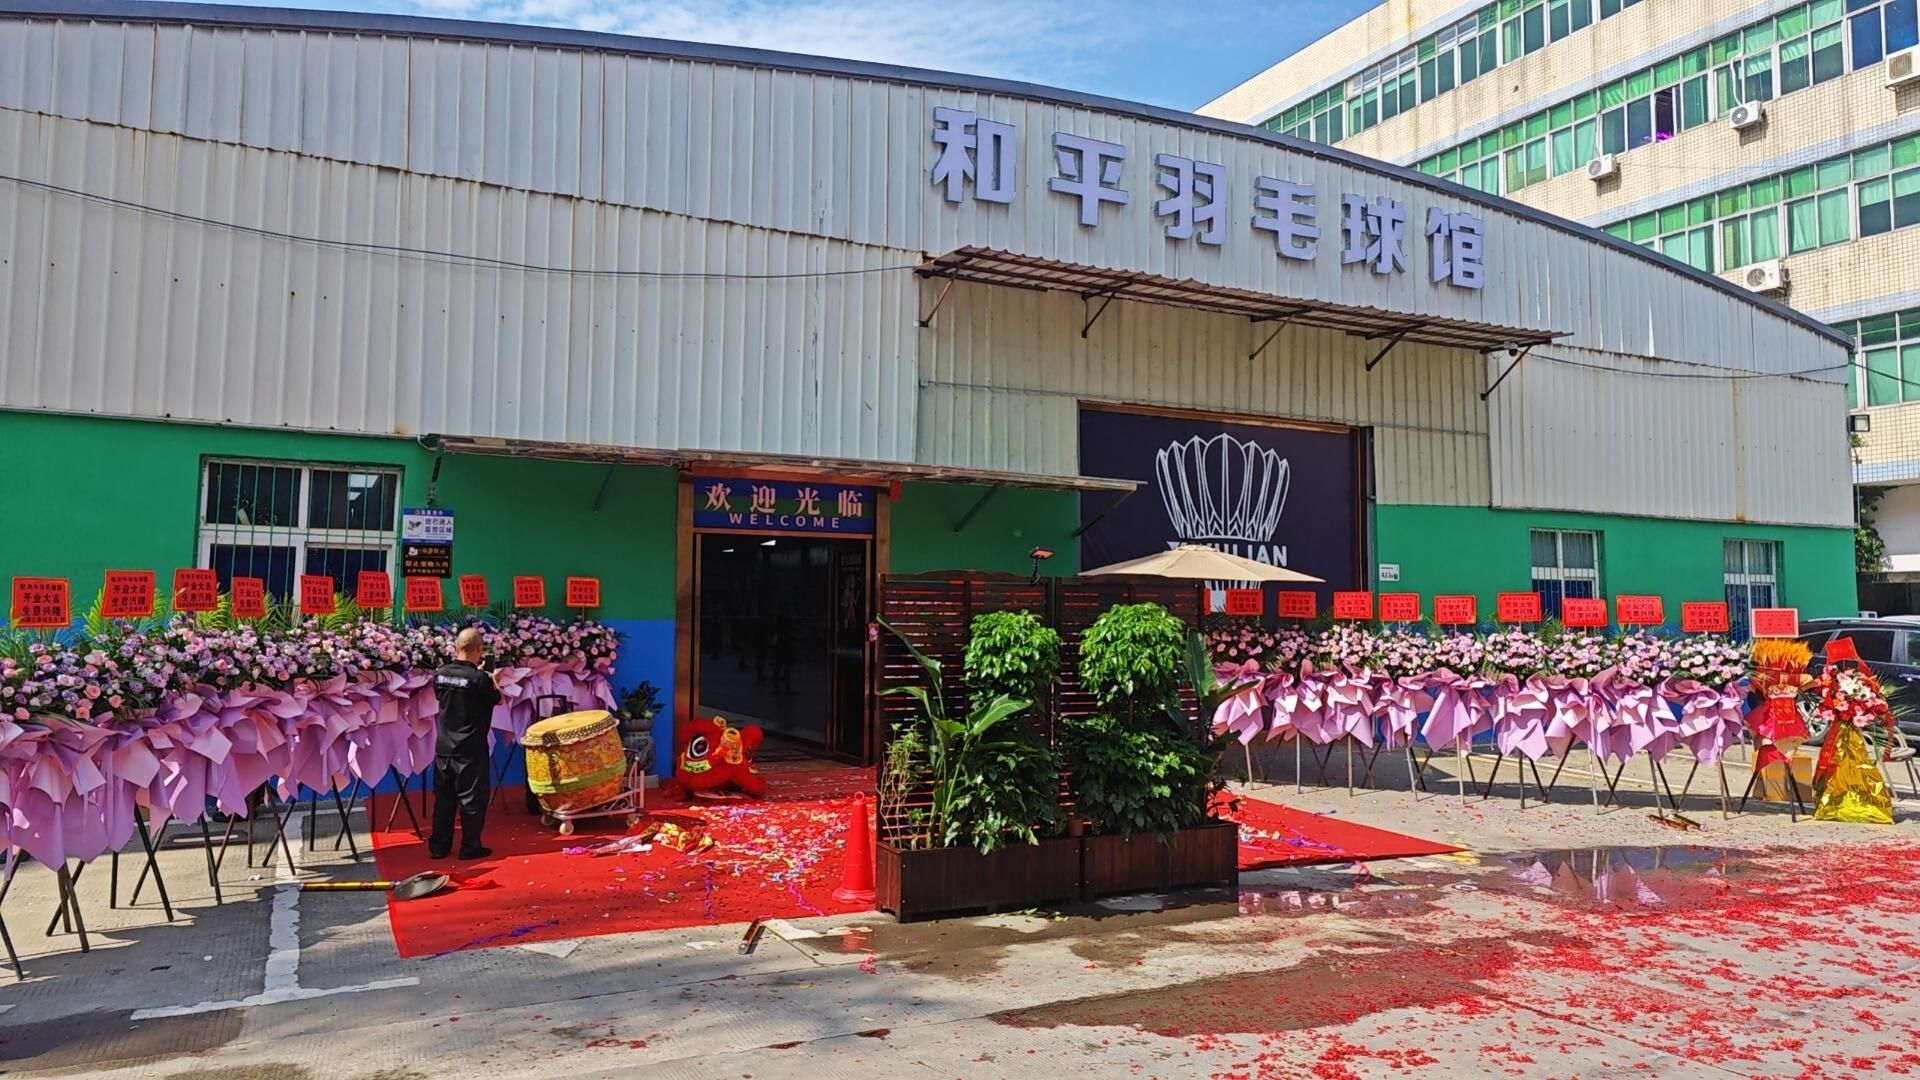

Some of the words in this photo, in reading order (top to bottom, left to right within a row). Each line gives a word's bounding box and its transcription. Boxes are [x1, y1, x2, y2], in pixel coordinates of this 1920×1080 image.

[932, 105, 1485, 290] 和平羽毛球馆
[703, 482, 864, 518] 欢迎光临
[729, 513, 841, 529] WELCOME
[112, 584, 147, 595] 开业大吉
[23, 592, 61, 604] 开业大吉
[22, 605, 62, 617] 生意兴隆
